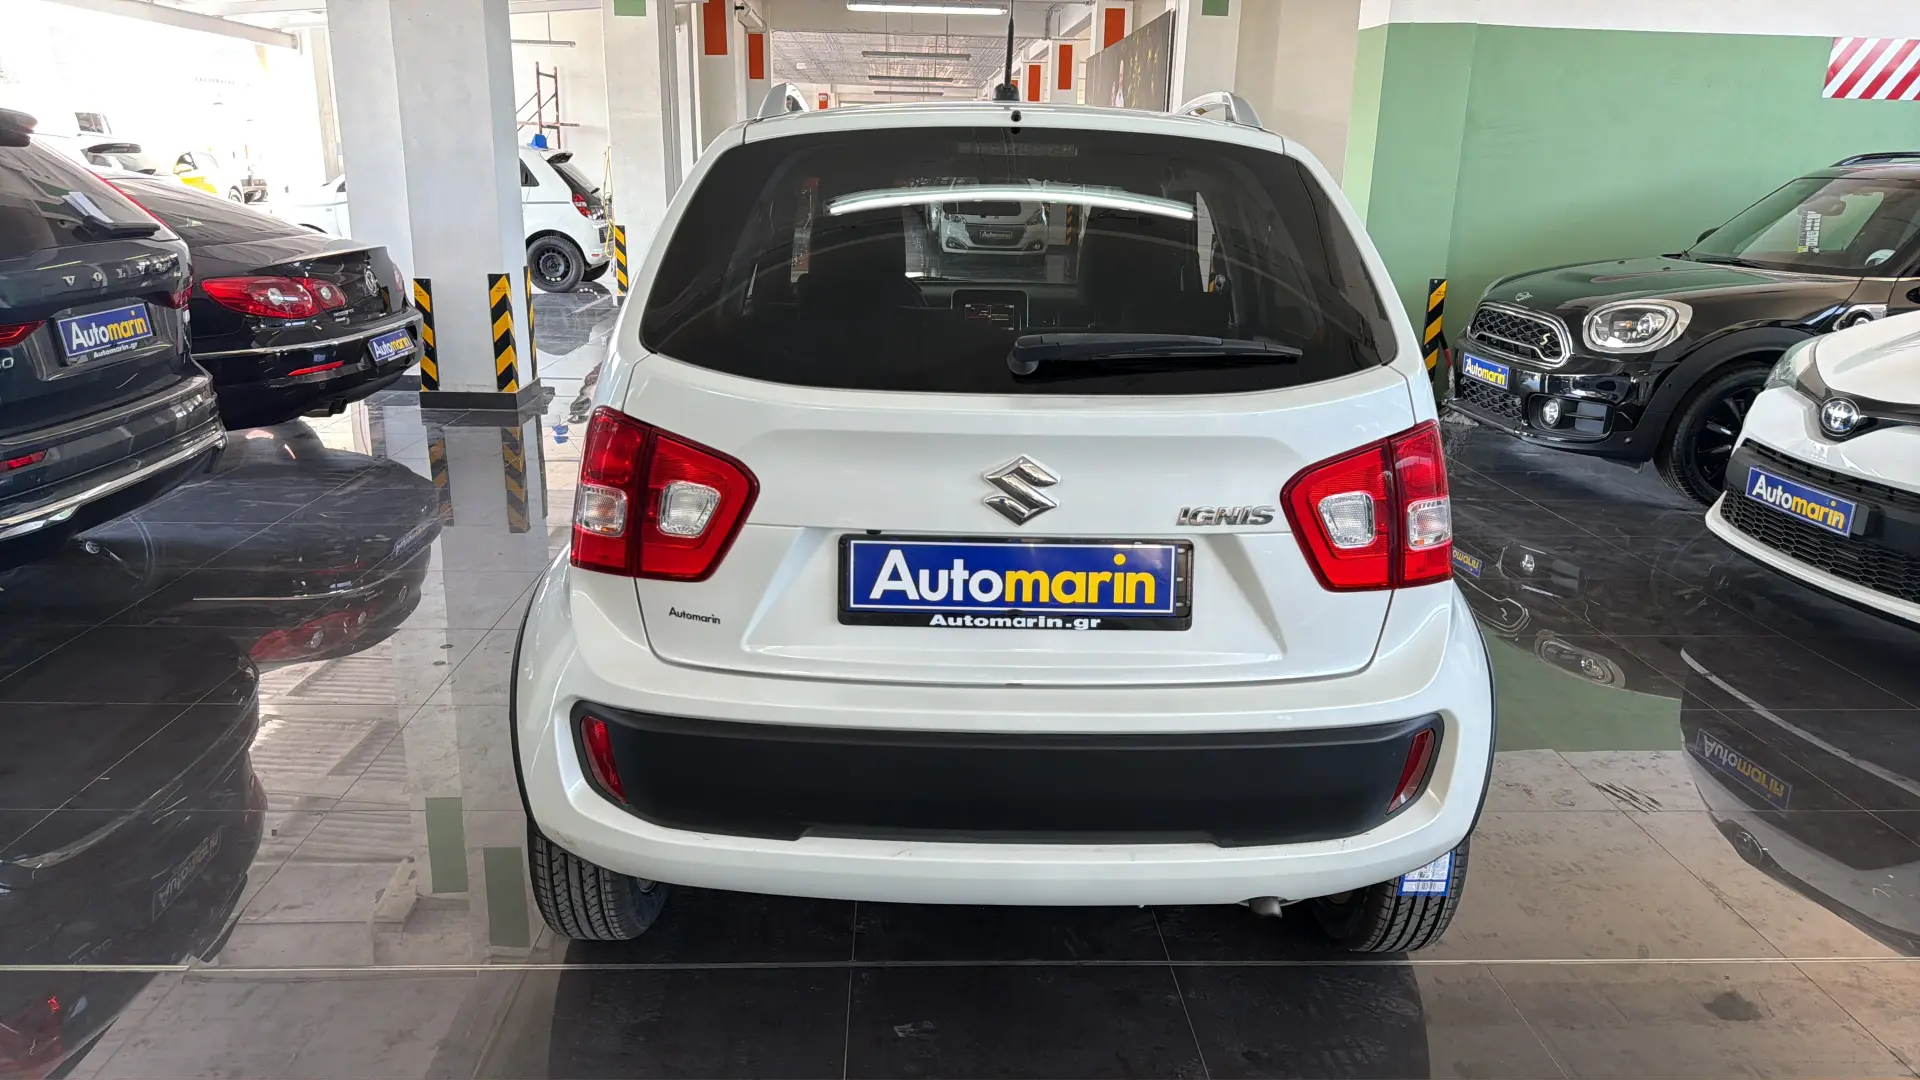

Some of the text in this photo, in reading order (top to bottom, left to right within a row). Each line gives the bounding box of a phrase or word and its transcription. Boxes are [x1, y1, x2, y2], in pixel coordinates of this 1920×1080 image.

[70, 309, 149, 351] Automarin
[93, 341, 138, 358] Automarin.gr
[371, 332, 411, 359] Automarin
[1465, 358, 1507, 386] Automarin
[1176, 504, 1276, 526] IGNIS
[1751, 474, 1846, 530] Automarin
[868, 548, 1156, 605] Automarin
[669, 606, 721, 625] Automarin
[929, 613, 1102, 631] Automarin.gr
